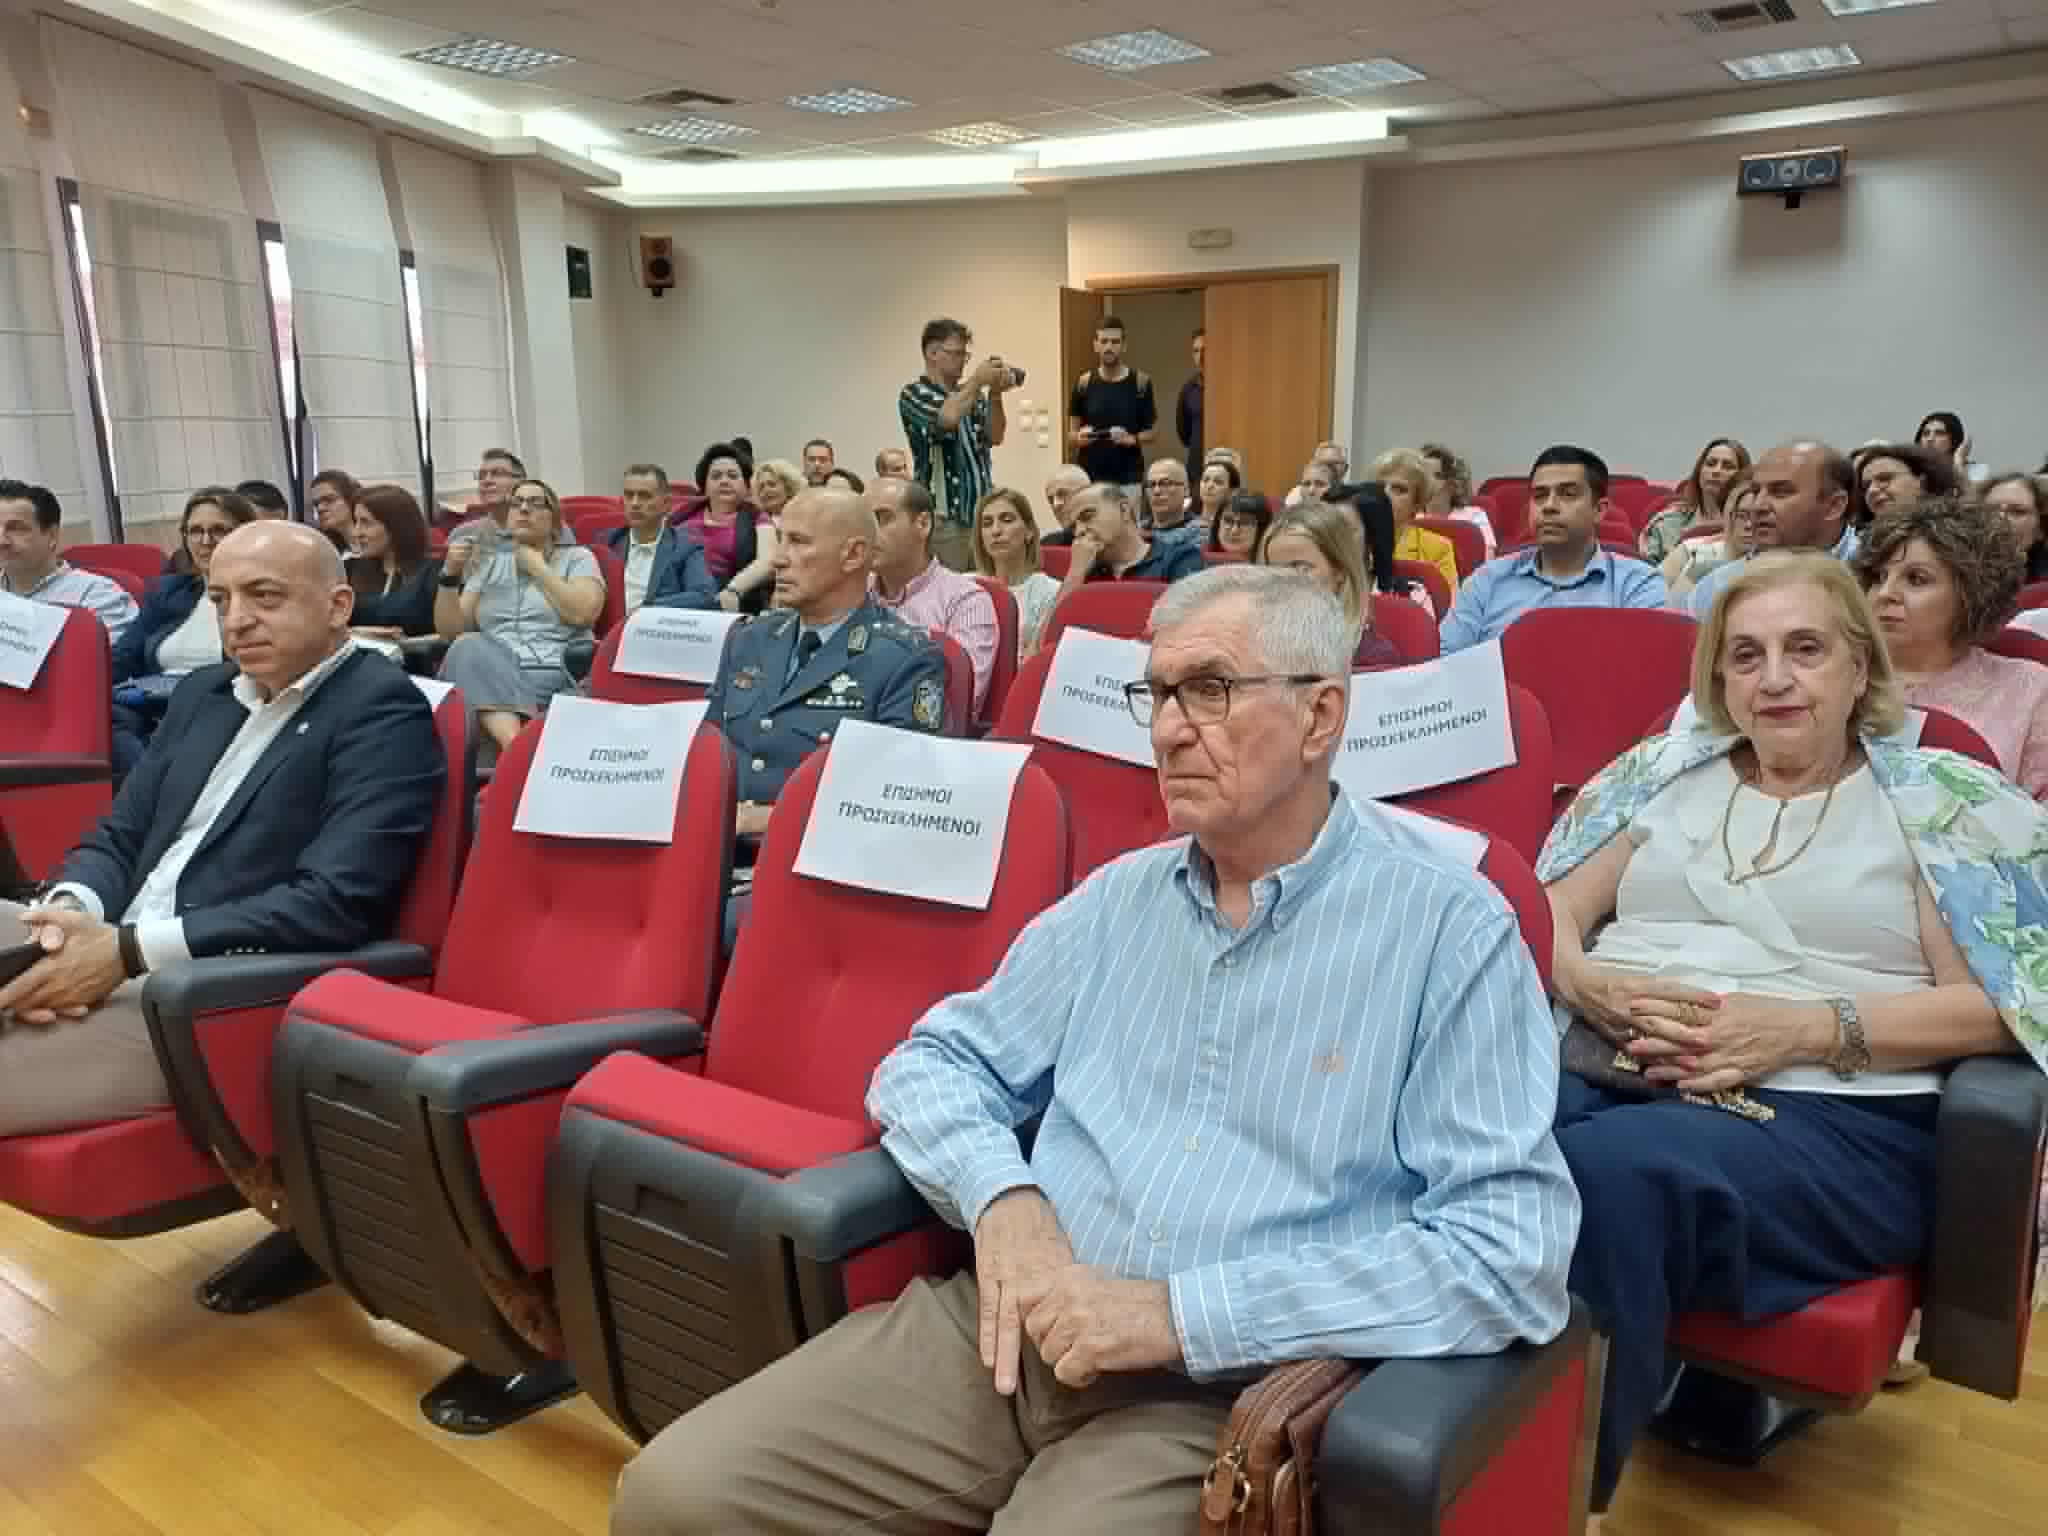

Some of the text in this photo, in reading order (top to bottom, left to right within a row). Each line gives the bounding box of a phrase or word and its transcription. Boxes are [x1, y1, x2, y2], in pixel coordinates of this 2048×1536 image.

[1095, 674, 1122, 691] ΕΠΙΣ
[1378, 699, 1453, 729] ΕΠΙΣΗΜΟΙ
[1346, 708, 1487, 752] ΠΡΟΣΚΕΚΛΗΜΕΝΟΙ
[881, 784, 952, 805] ΕΠΙΣΗΜΟΙ
[838, 802, 982, 836] ΠΡΟΣΚΕΚΛΗΜΕΝΟΙ
